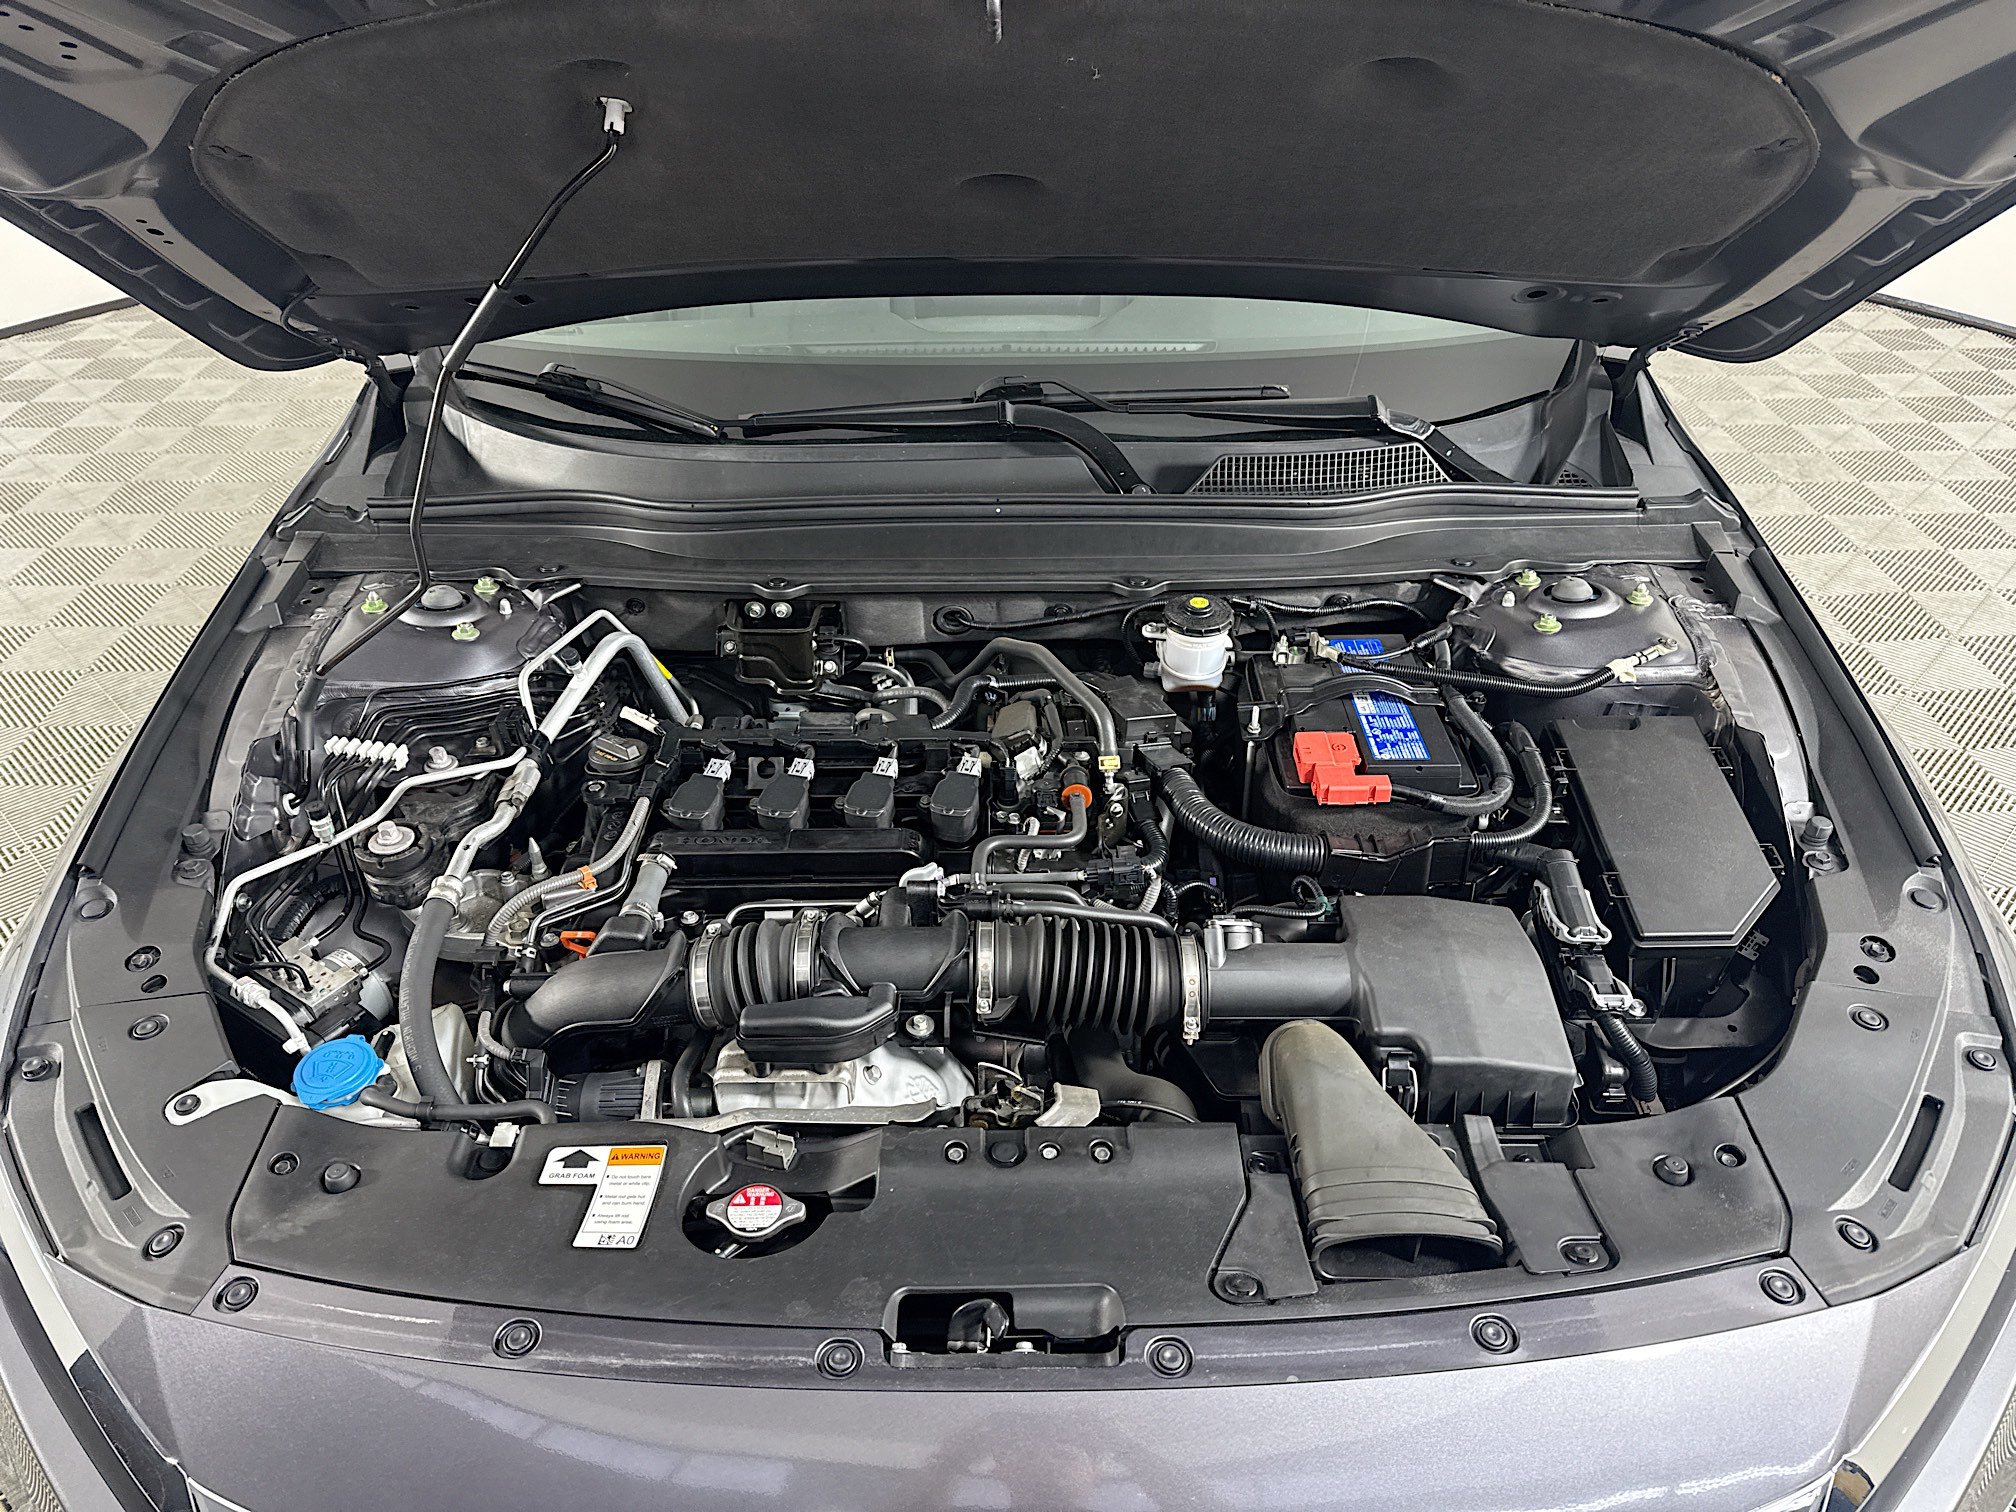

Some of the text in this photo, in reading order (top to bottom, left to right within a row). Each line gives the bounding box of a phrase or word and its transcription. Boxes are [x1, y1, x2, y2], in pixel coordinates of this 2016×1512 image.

[675, 836, 772, 845] HONDA
[402, 1025, 419, 1062] NICHIRIN
[620, 1152, 661, 1160] WARNING
[615, 1235, 635, 1246] A0
